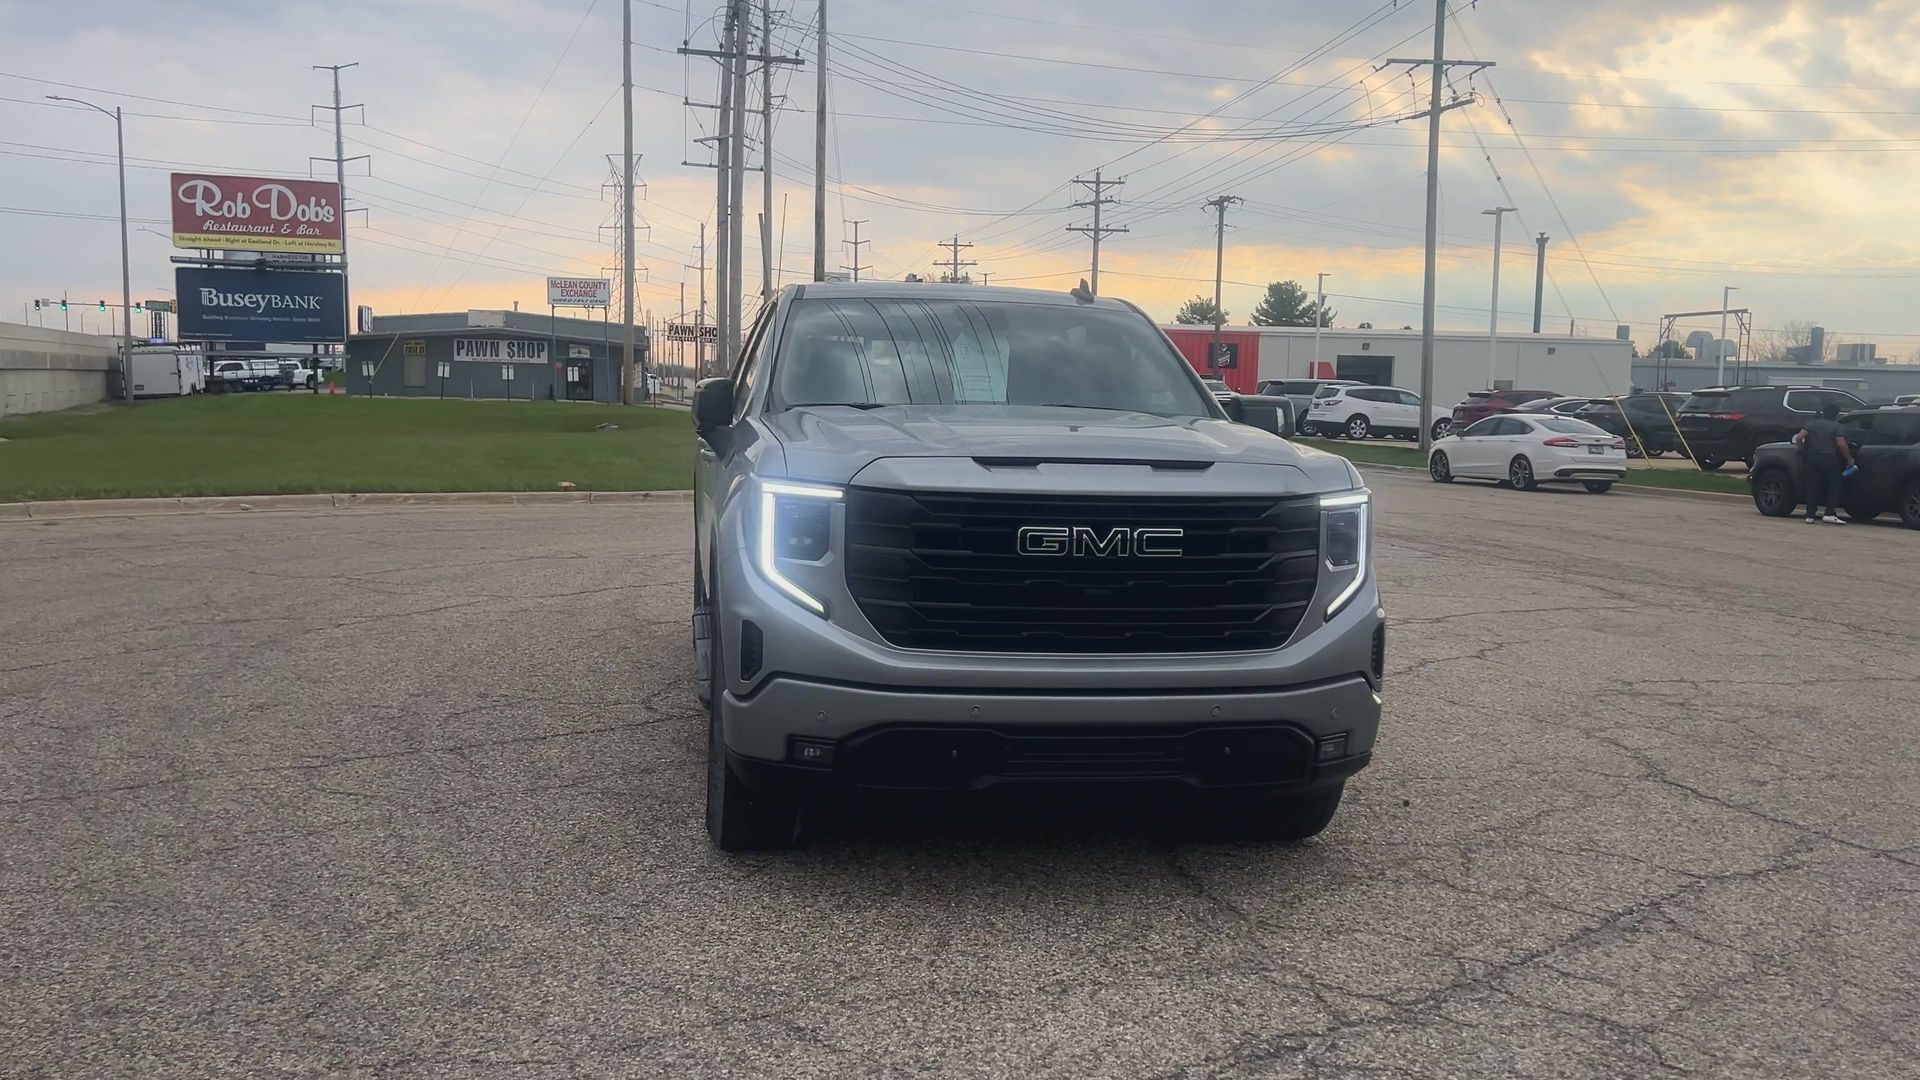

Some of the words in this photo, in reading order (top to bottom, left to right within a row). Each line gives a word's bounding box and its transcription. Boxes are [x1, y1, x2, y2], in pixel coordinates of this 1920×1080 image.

[178, 179, 251, 219] Rob
[252, 184, 335, 223] Dob's
[203, 220, 276, 234] Restaurant
[281, 223, 292, 235] &
[297, 224, 323, 236] Bar
[550, 280, 577, 289] McLEAN
[578, 281, 606, 290] COUNTY
[560, 289, 597, 298] EXCHANGE
[669, 324, 694, 337] PAWN
[699, 326, 718, 338] SHO
[456, 339, 500, 358] PAWN
[1017, 526, 1184, 557] GMC
